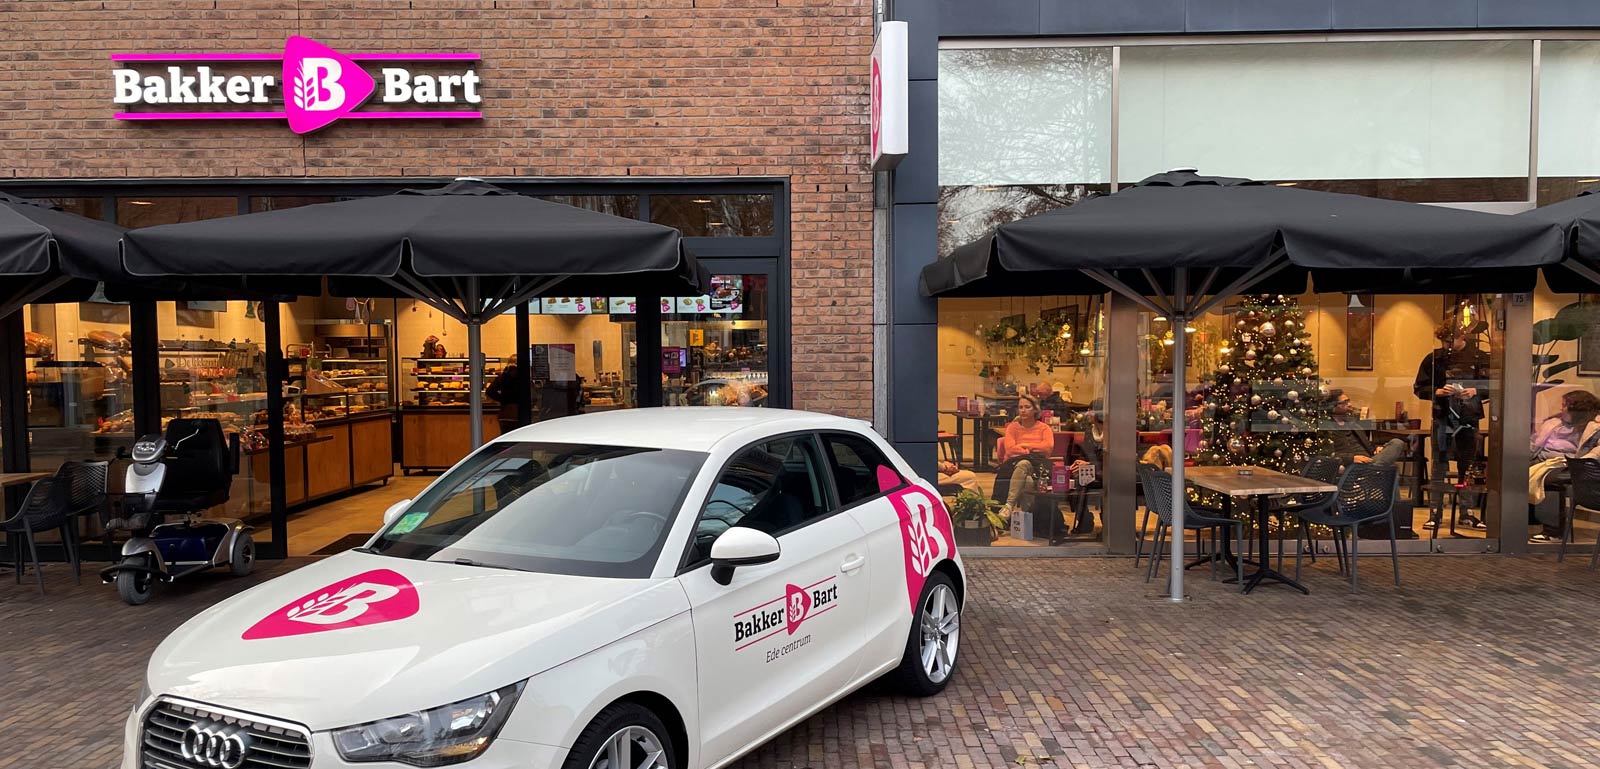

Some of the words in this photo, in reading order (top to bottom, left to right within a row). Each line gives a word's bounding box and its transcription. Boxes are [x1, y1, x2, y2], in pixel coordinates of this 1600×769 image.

[112, 66, 275, 104] Bakker
[295, 57, 346, 111] B
[382, 68, 481, 103] Bart
[1514, 295, 1524, 303] 75
[901, 491, 949, 578] B
[734, 608, 785, 643] Bakker
[789, 591, 805, 623] B
[812, 583, 838, 609] Bart
[766, 648, 780, 664] Ede
[780, 634, 812, 656] centrum
